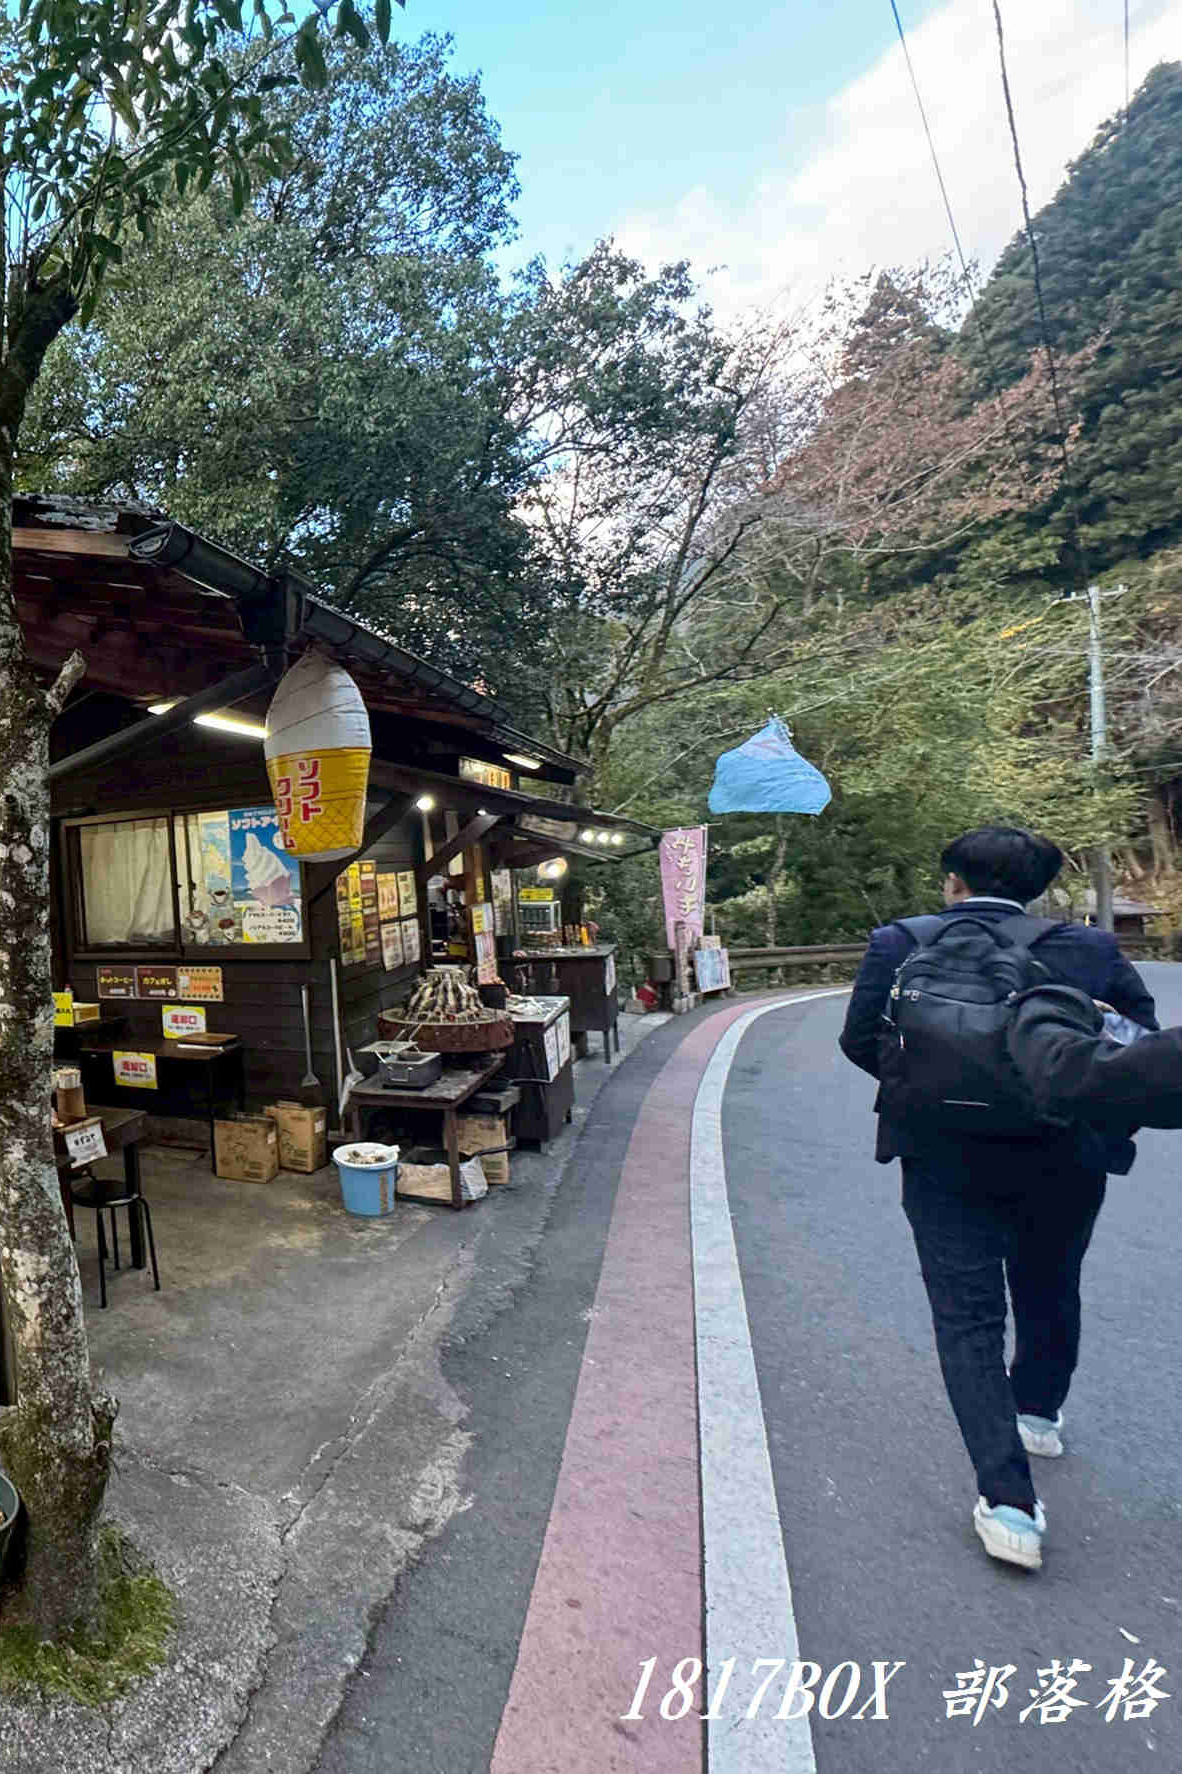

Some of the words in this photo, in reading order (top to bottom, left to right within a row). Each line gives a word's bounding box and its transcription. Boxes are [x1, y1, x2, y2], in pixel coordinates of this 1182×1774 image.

[275, 777, 296, 849] クリーム
[298, 760, 322, 822] ソフト
